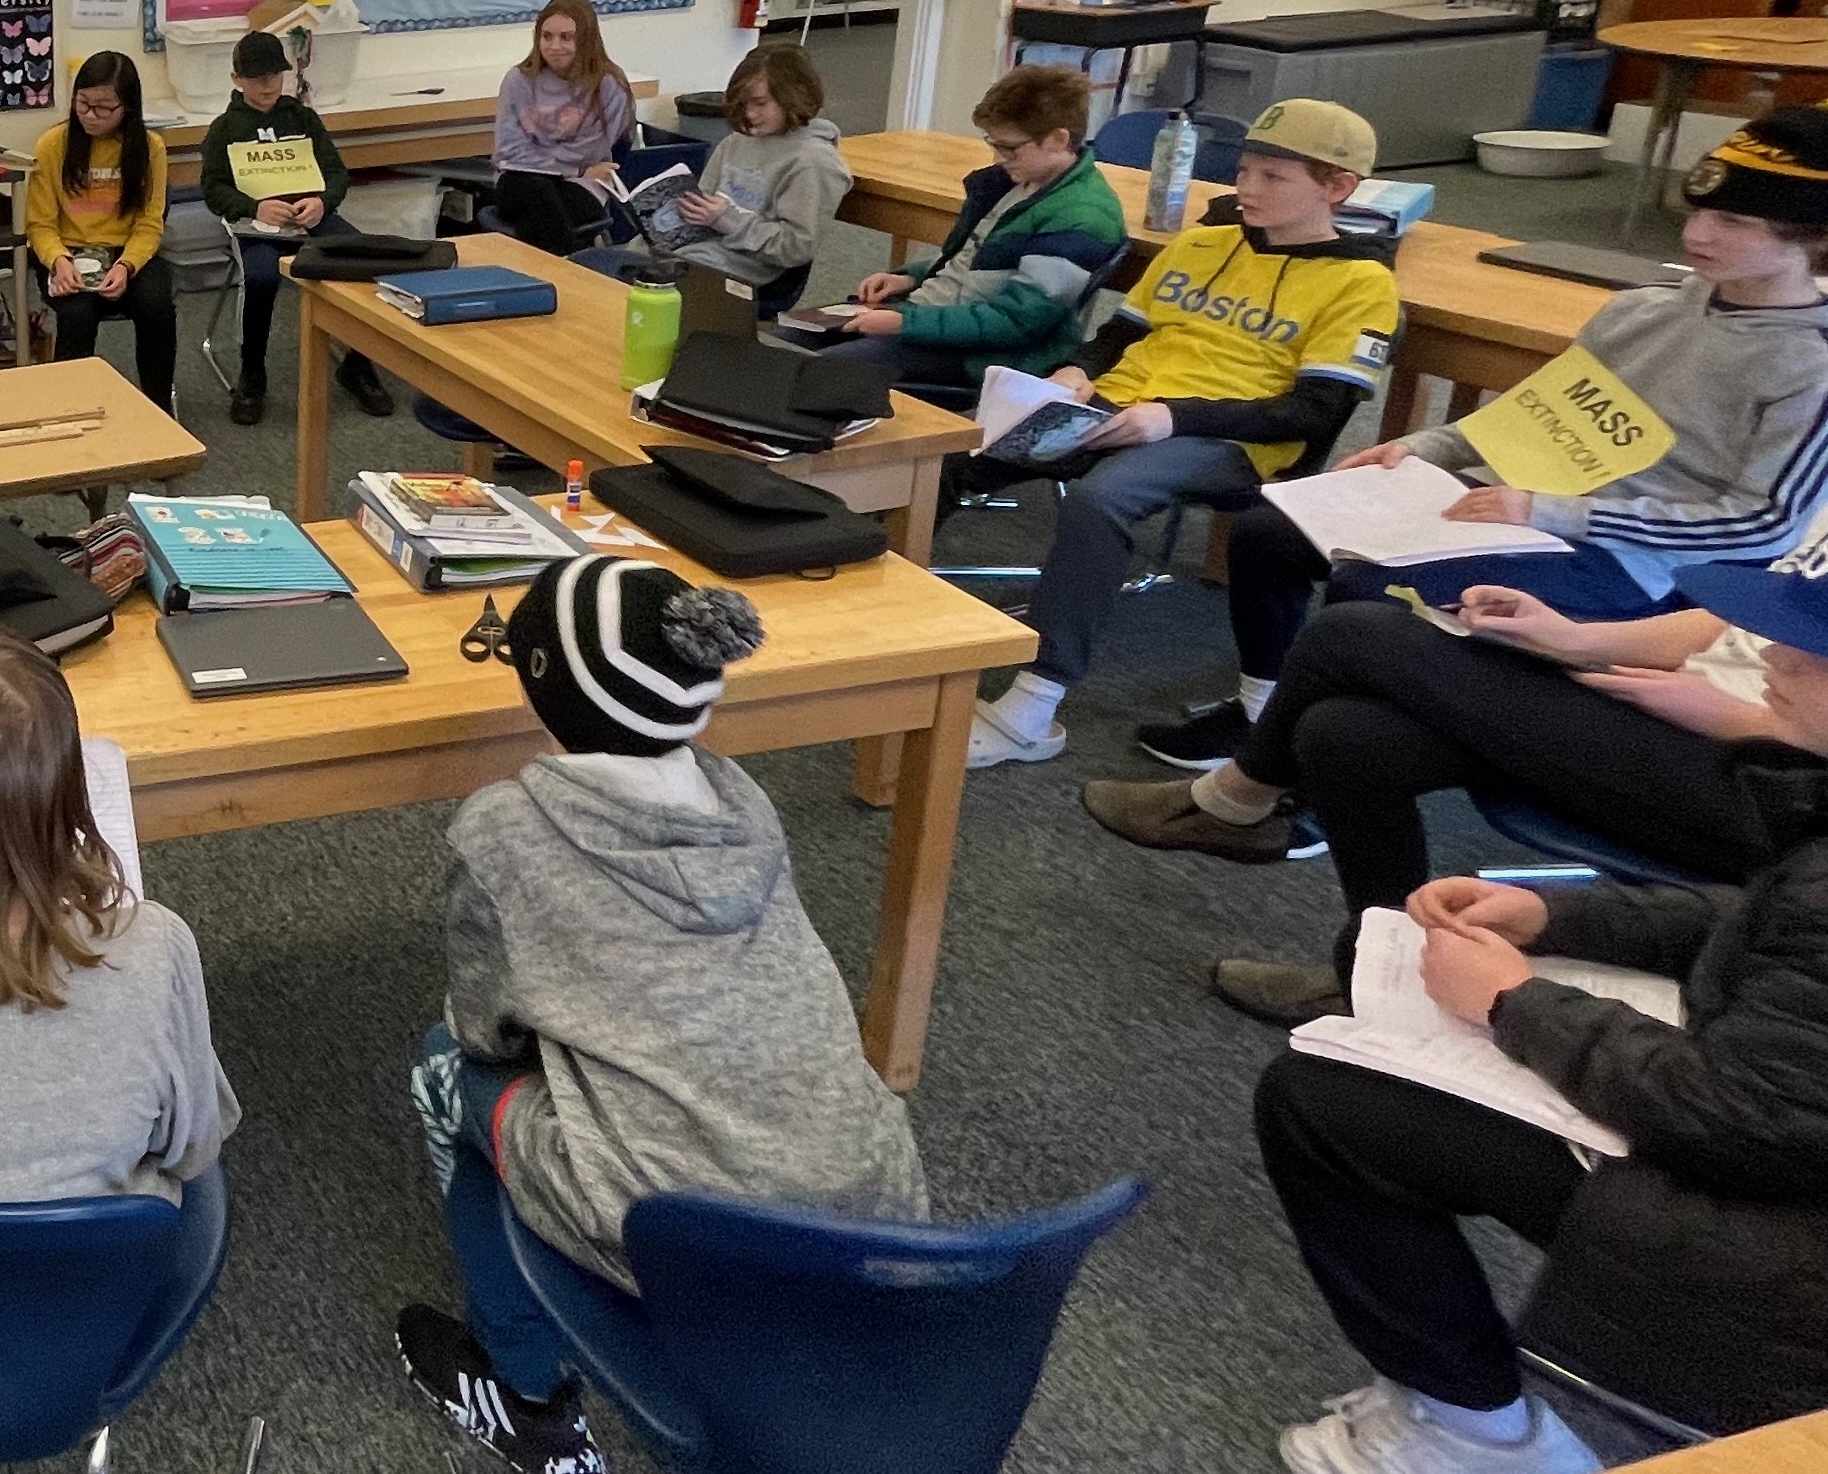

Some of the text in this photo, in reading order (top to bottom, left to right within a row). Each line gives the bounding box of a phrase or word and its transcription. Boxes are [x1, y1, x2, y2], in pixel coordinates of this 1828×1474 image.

[246, 148, 296, 163] MASS
[1153, 269, 1300, 343] Boston
[1563, 378, 1644, 447] MASS
